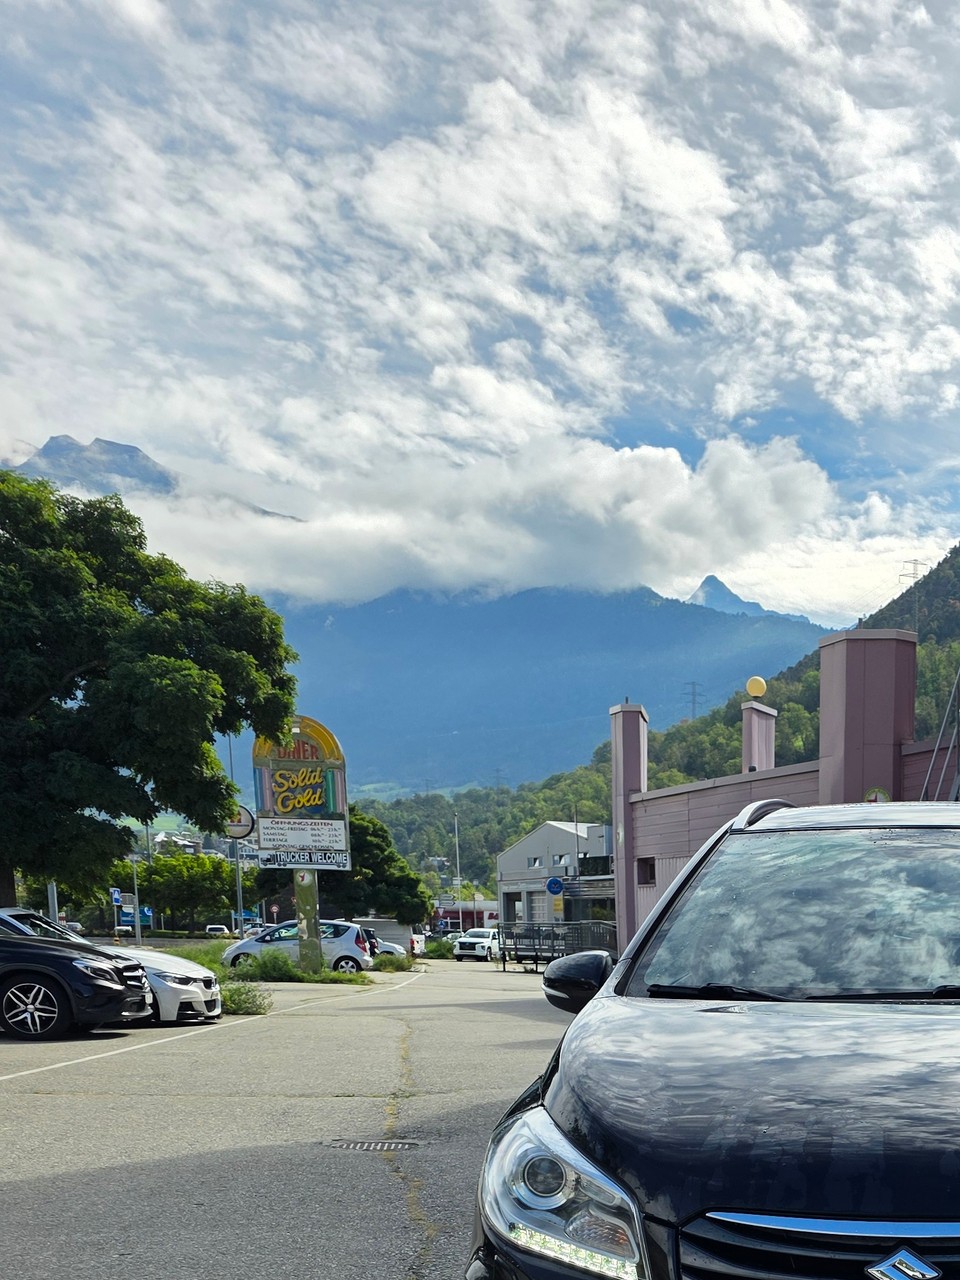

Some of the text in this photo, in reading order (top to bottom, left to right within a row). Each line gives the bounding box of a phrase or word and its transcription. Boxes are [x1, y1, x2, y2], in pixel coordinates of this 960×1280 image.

[272, 767, 323, 793] Solid
[277, 787, 325, 813] Gold
[276, 851, 348, 864] TRUCKER WELCOME
